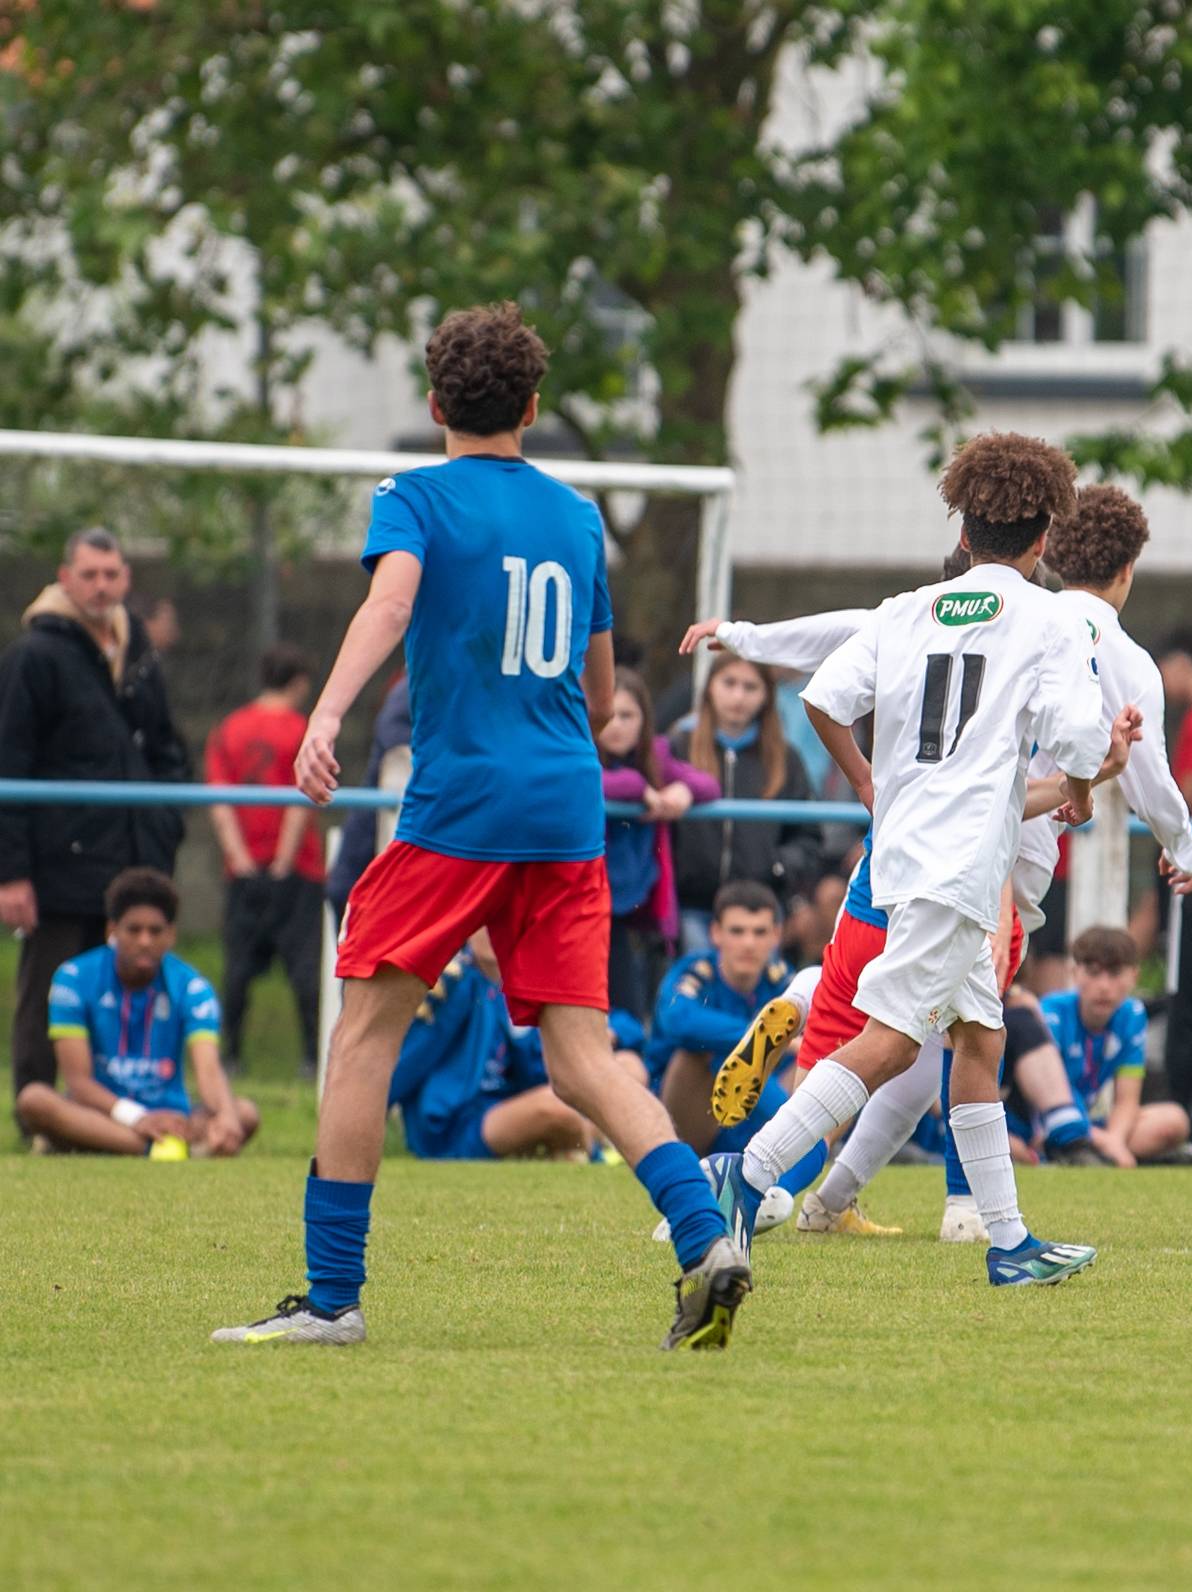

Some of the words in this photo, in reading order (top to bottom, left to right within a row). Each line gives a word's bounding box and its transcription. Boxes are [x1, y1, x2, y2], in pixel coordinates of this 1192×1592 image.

[501, 556, 573, 678] 10
[939, 598, 981, 618] PMU
[915, 653, 987, 763] 11
